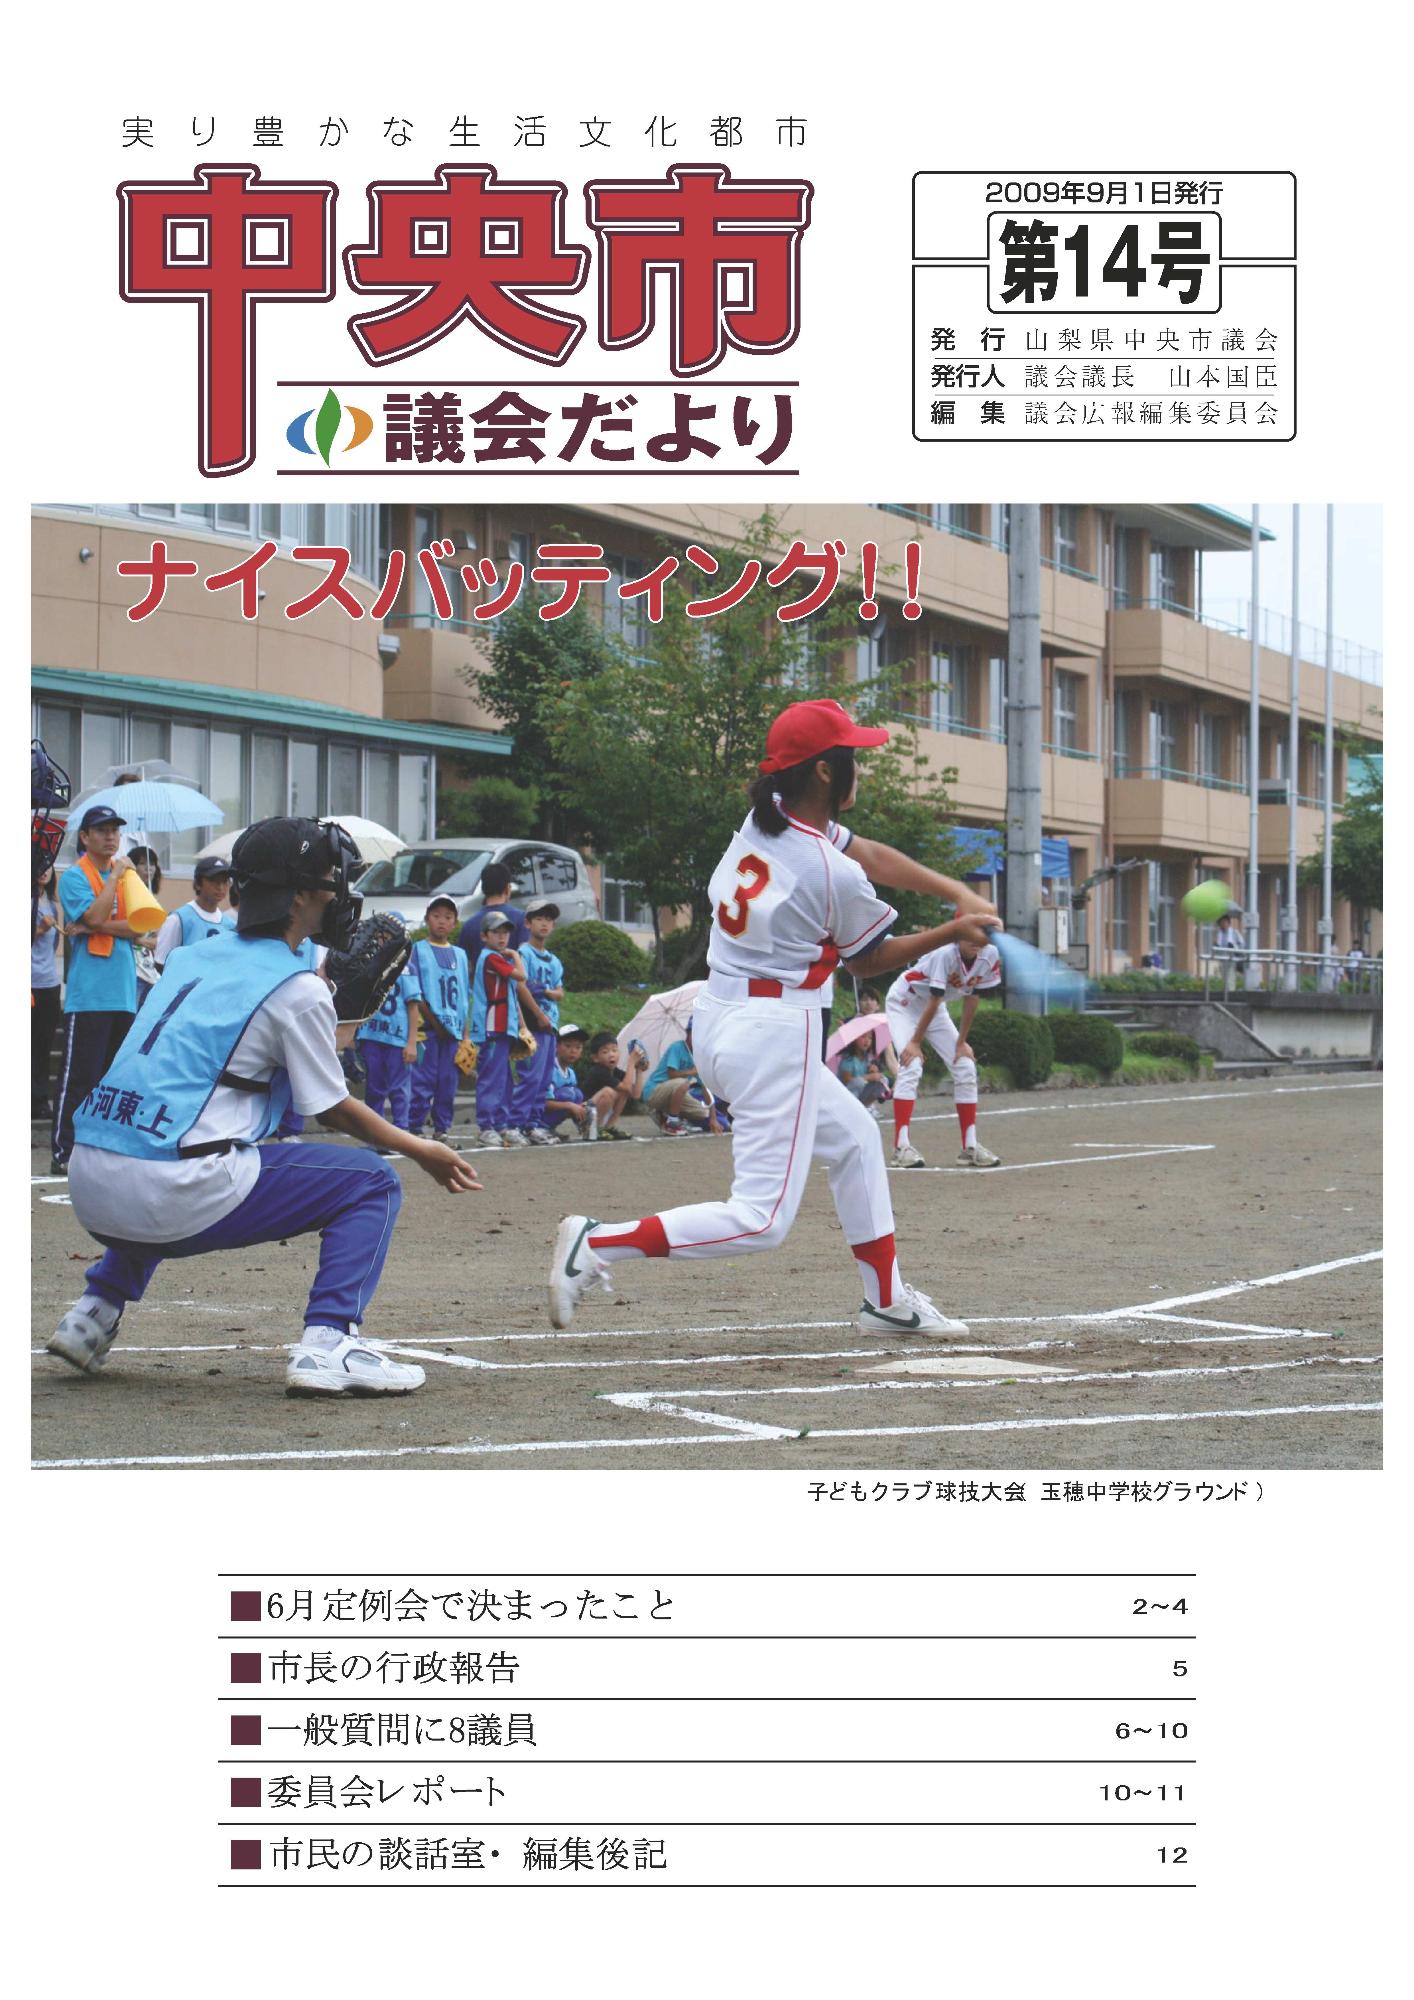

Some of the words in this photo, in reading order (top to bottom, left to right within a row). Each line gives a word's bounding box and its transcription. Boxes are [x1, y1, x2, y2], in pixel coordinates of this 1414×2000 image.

[121, 114, 808, 148] 実り豊かな生活文化都市
[985, 180, 1224, 205] 2009年9月1日発行
[998, 218, 1211, 305] 第14号
[116, 163, 815, 479] 中央市
[1025, 327, 1279, 352] 山梨県中央市議会
[930, 363, 1006, 388] 発行人
[1024, 364, 1135, 388] 議会議長
[1169, 364, 1279, 388] 山本国臣
[382, 390, 794, 466] 議会だより
[1024, 400, 1279, 425] 議会広報編集委員会
[718, 853, 771, 939] 3
[438, 975, 458, 1011] 16
[267, 1587, 673, 1623] 6月定例会で決まったこと
[268, 1649, 520, 1685] 市長の行政報告
[1172, 1660, 1188, 1677] 5
[267, 1712, 537, 1747] 一般質問に8議員
[267, 1774, 505, 1809] 委員会レポート
[1157, 1846, 1188, 1864] 12
